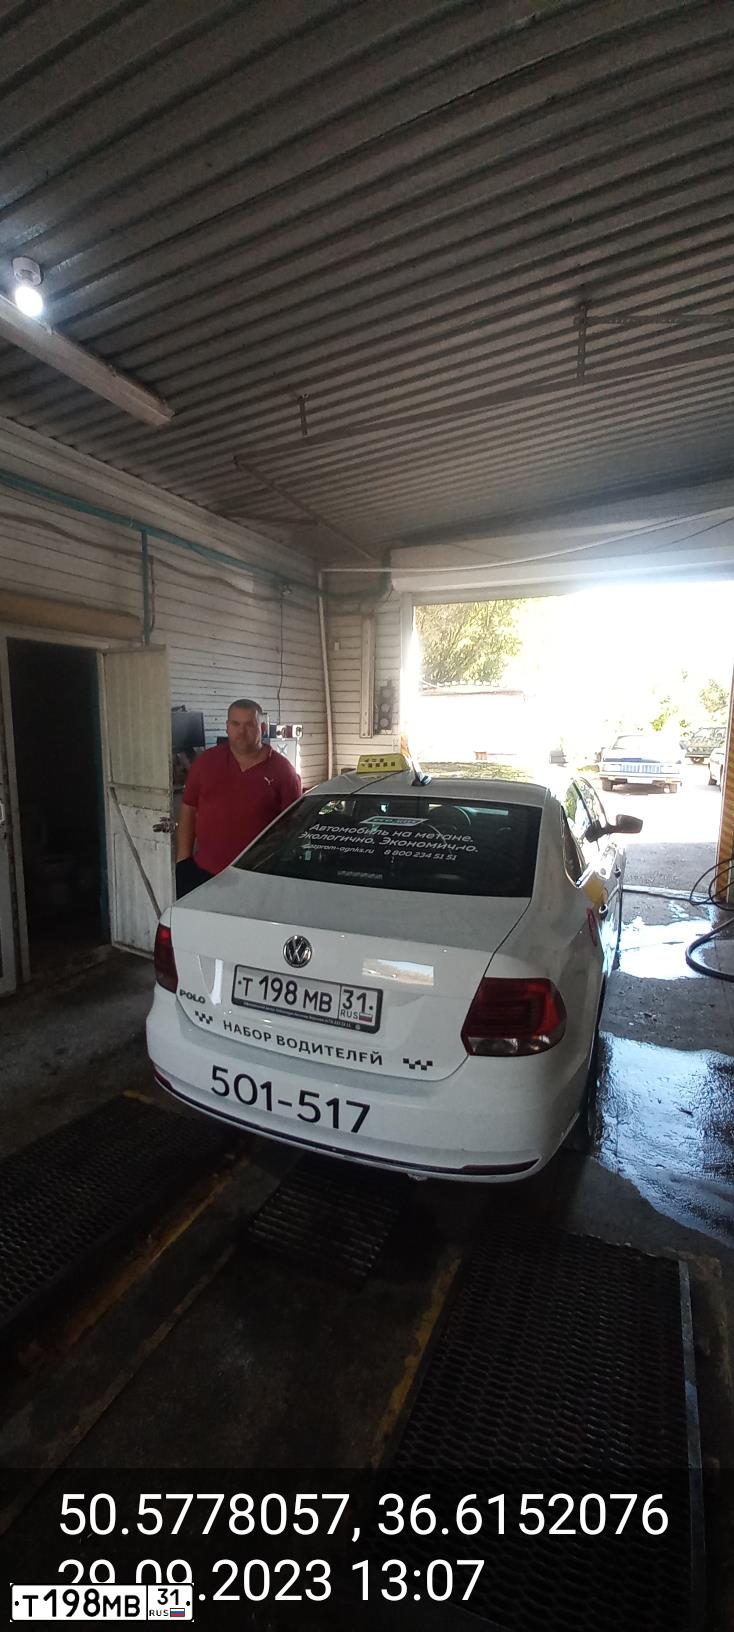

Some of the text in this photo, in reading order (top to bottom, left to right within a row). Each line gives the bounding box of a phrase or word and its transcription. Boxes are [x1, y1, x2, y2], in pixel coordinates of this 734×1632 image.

[298, 831, 479, 853] Экологично. Экономично.
[309, 823, 474, 843] Автомобиль на метане.
[301, 843, 375, 854] zprom-agnks.ru
[179, 989, 206, 1004] POLO
[242, 975, 367, 1013] Т 198 МВ 31
[340, 1010, 359, 1019] RUS
[223, 1020, 272, 1042] НАБОР
[211, 1064, 370, 1133] 501-517
